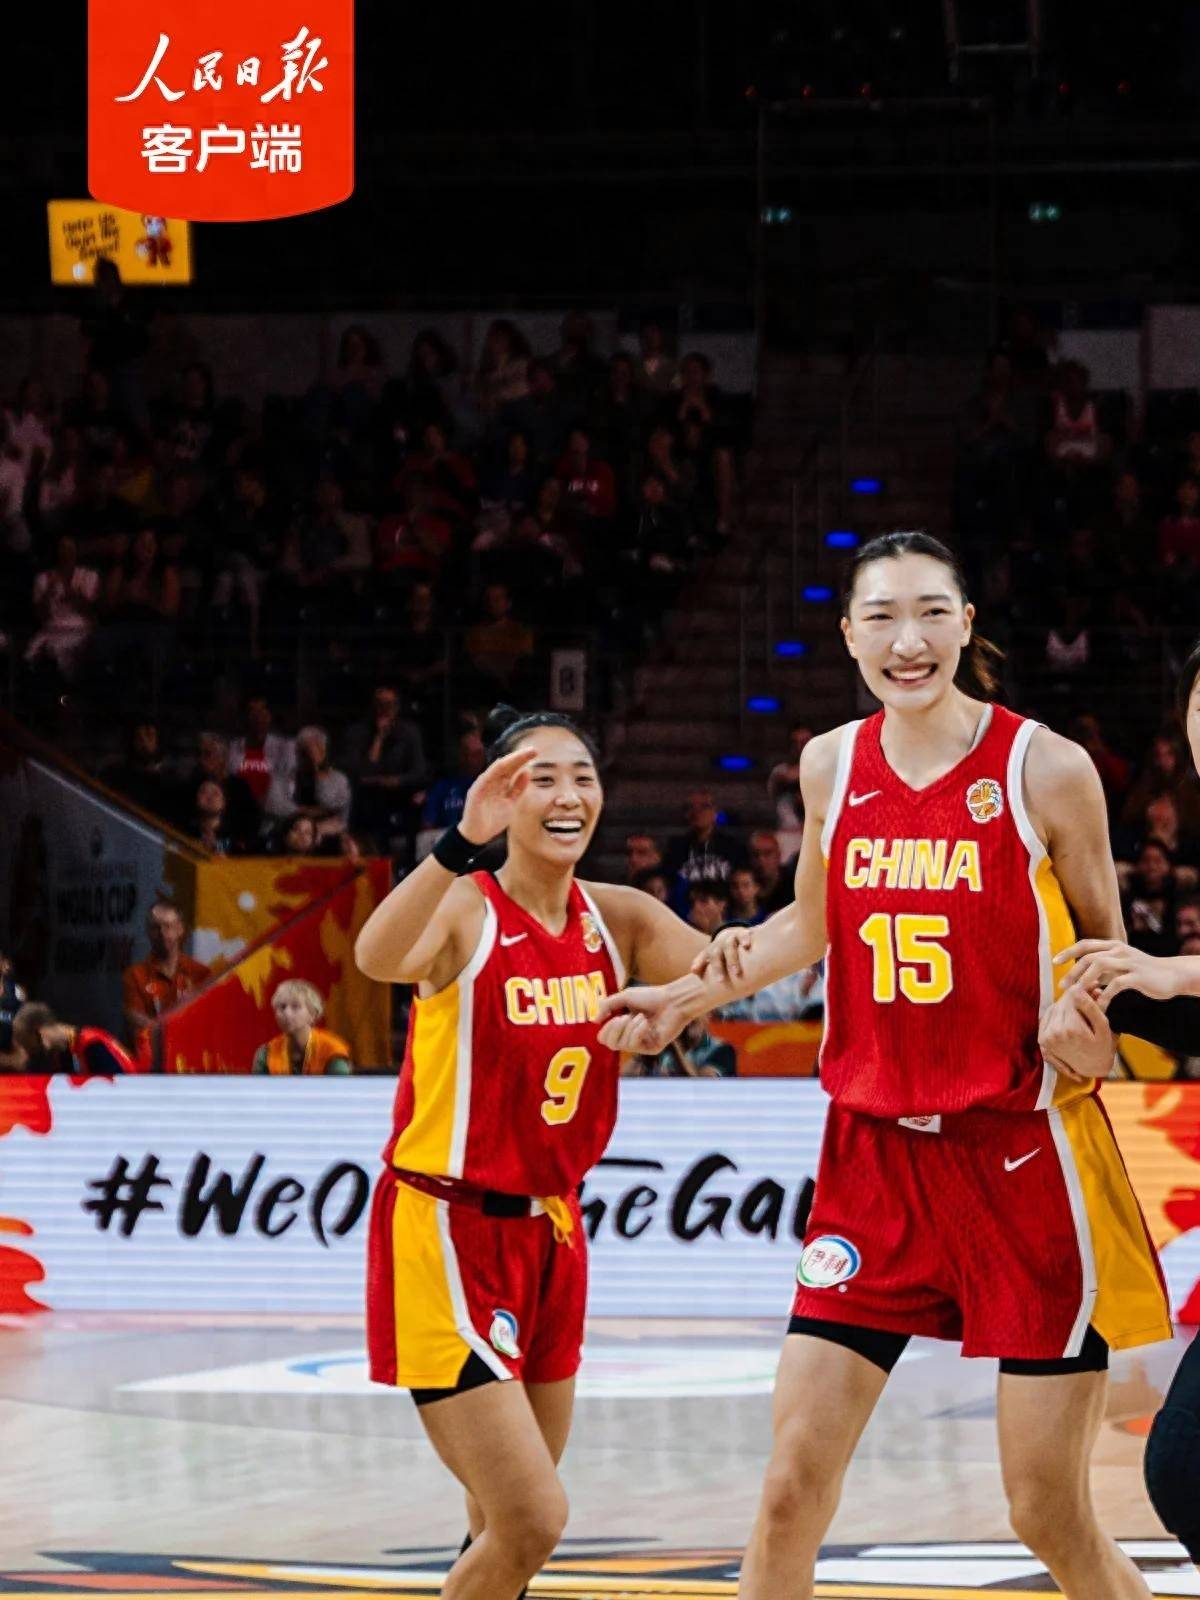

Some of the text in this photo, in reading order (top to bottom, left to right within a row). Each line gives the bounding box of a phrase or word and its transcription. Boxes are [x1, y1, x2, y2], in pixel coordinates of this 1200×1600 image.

[844, 837, 983, 892] CHINA
[858, 912, 954, 1004] 15
[540, 1046, 592, 1126] 9
